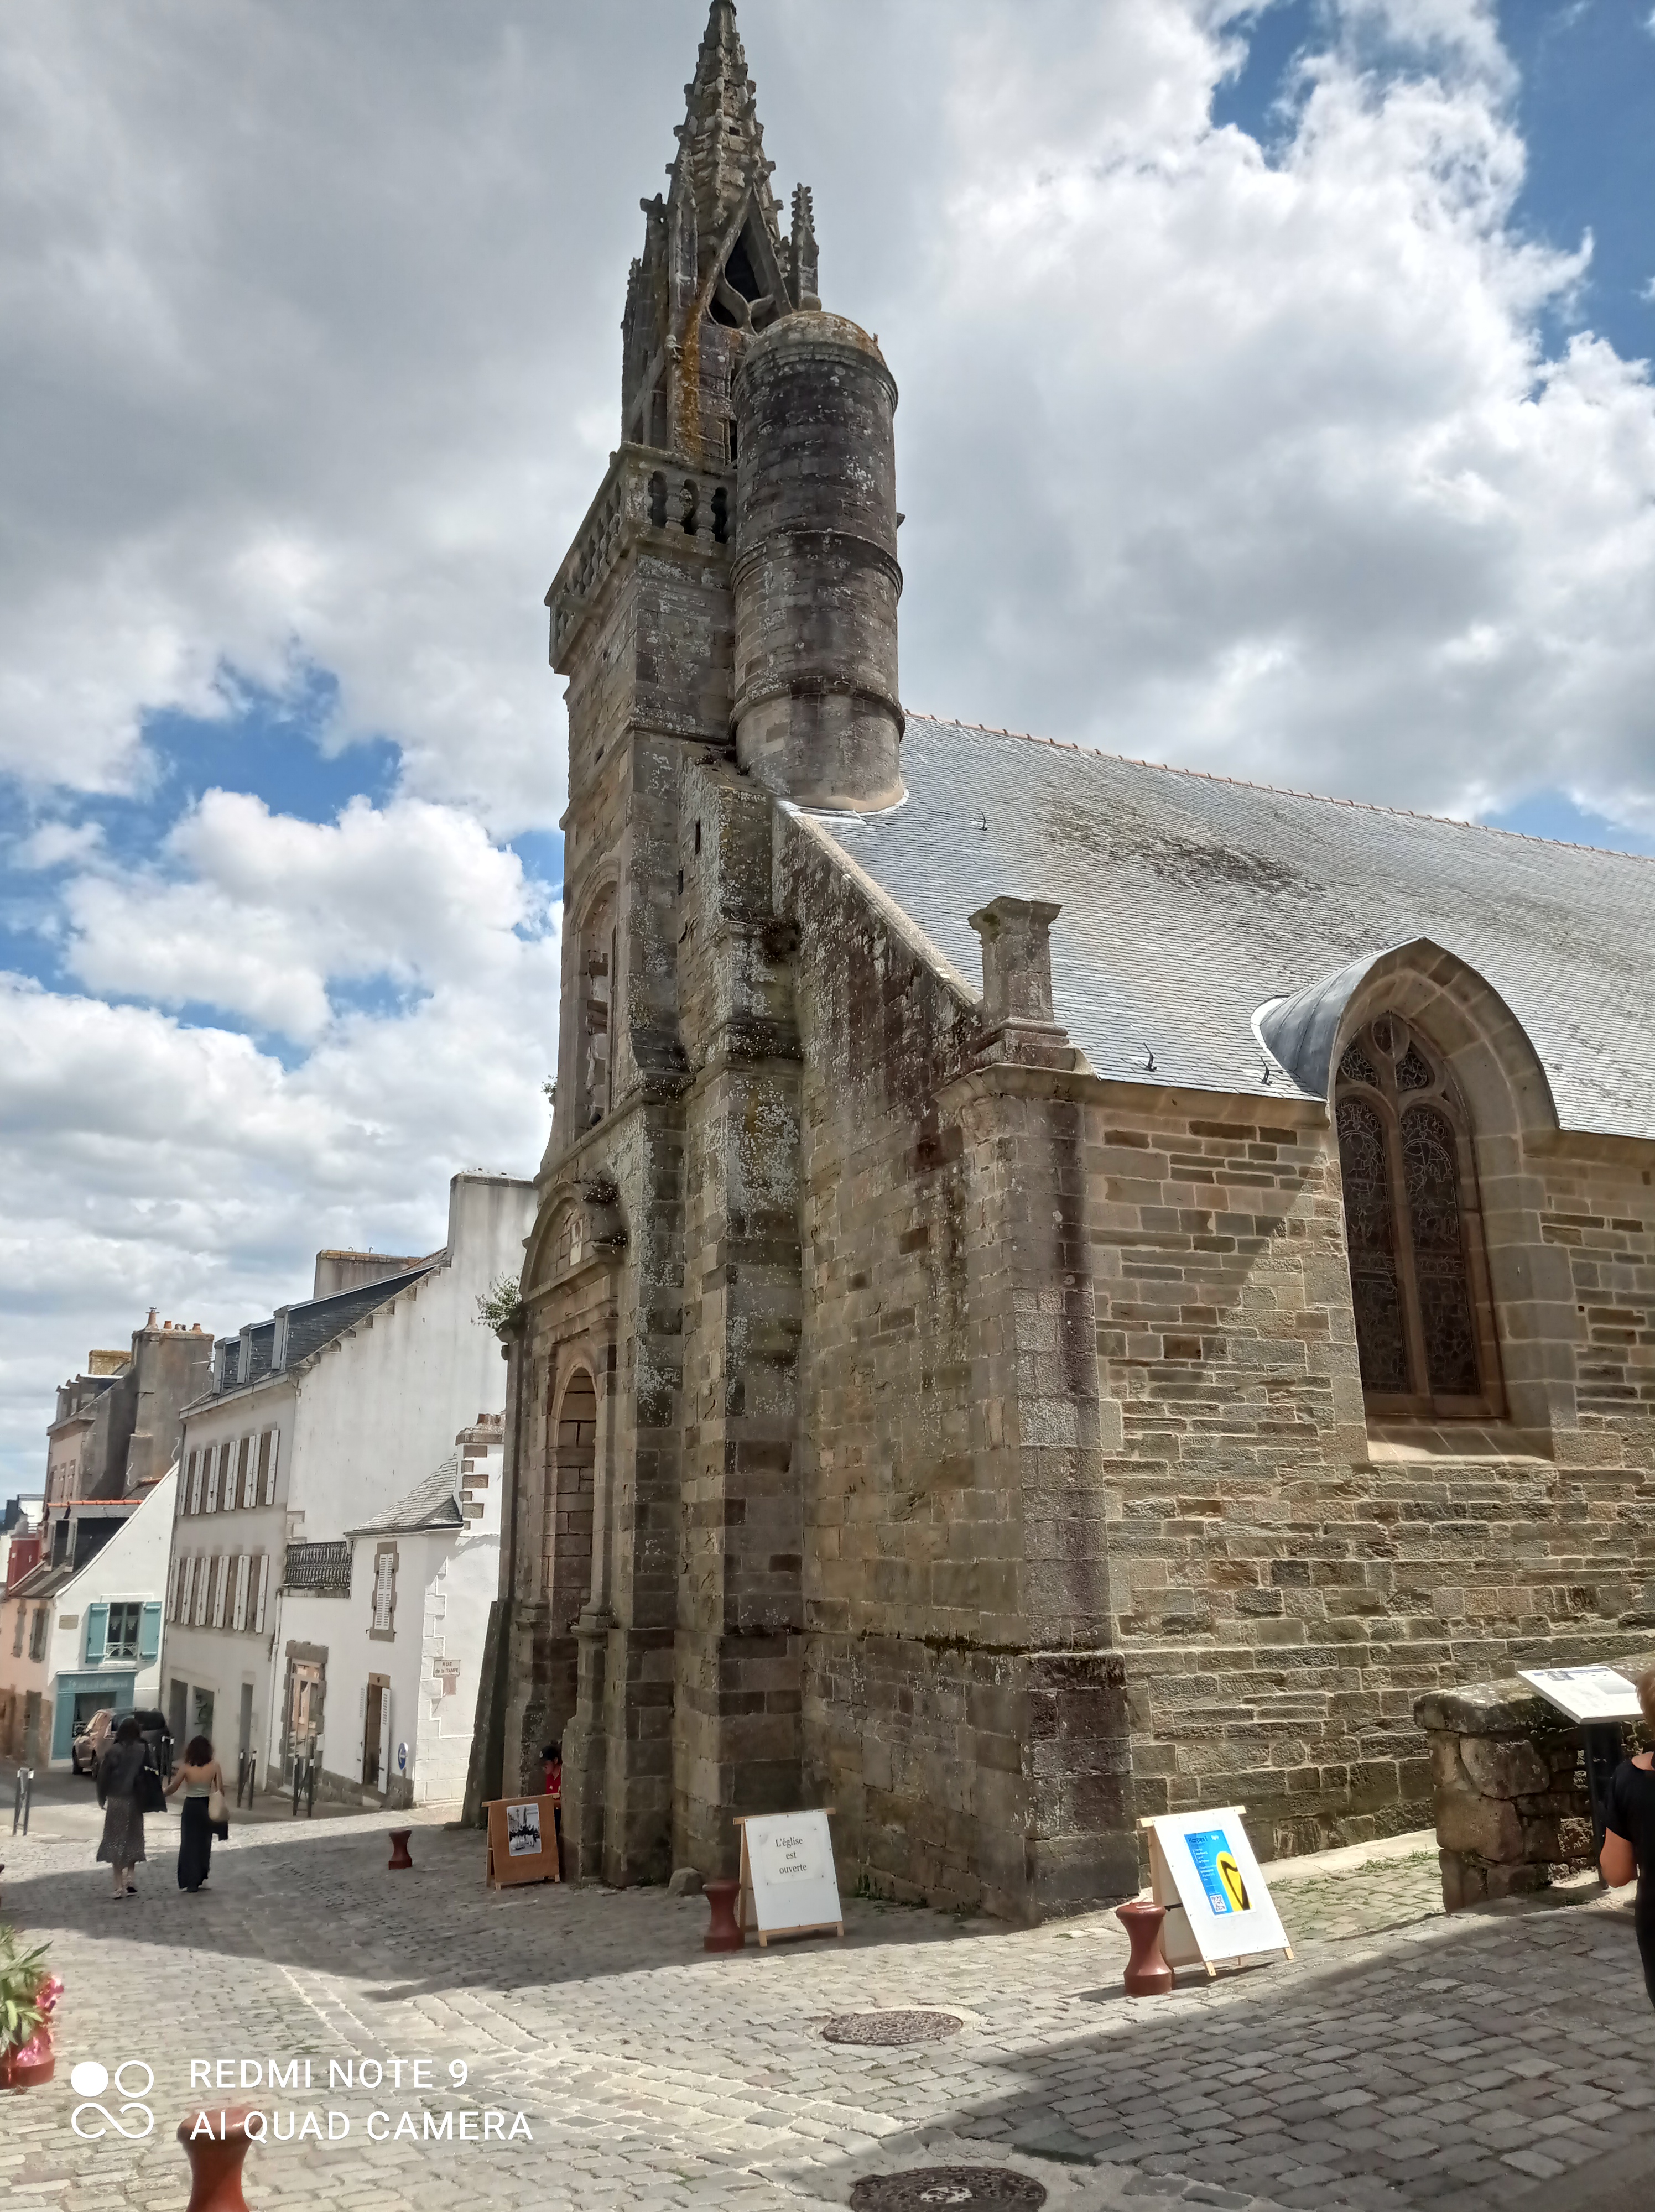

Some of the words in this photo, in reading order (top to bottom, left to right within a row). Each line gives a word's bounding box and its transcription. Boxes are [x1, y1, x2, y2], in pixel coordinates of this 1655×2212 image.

[775, 1836, 803, 1848] L’église
[785, 1851, 797, 1860] est
[779, 1864, 807, 1874] ouverte
